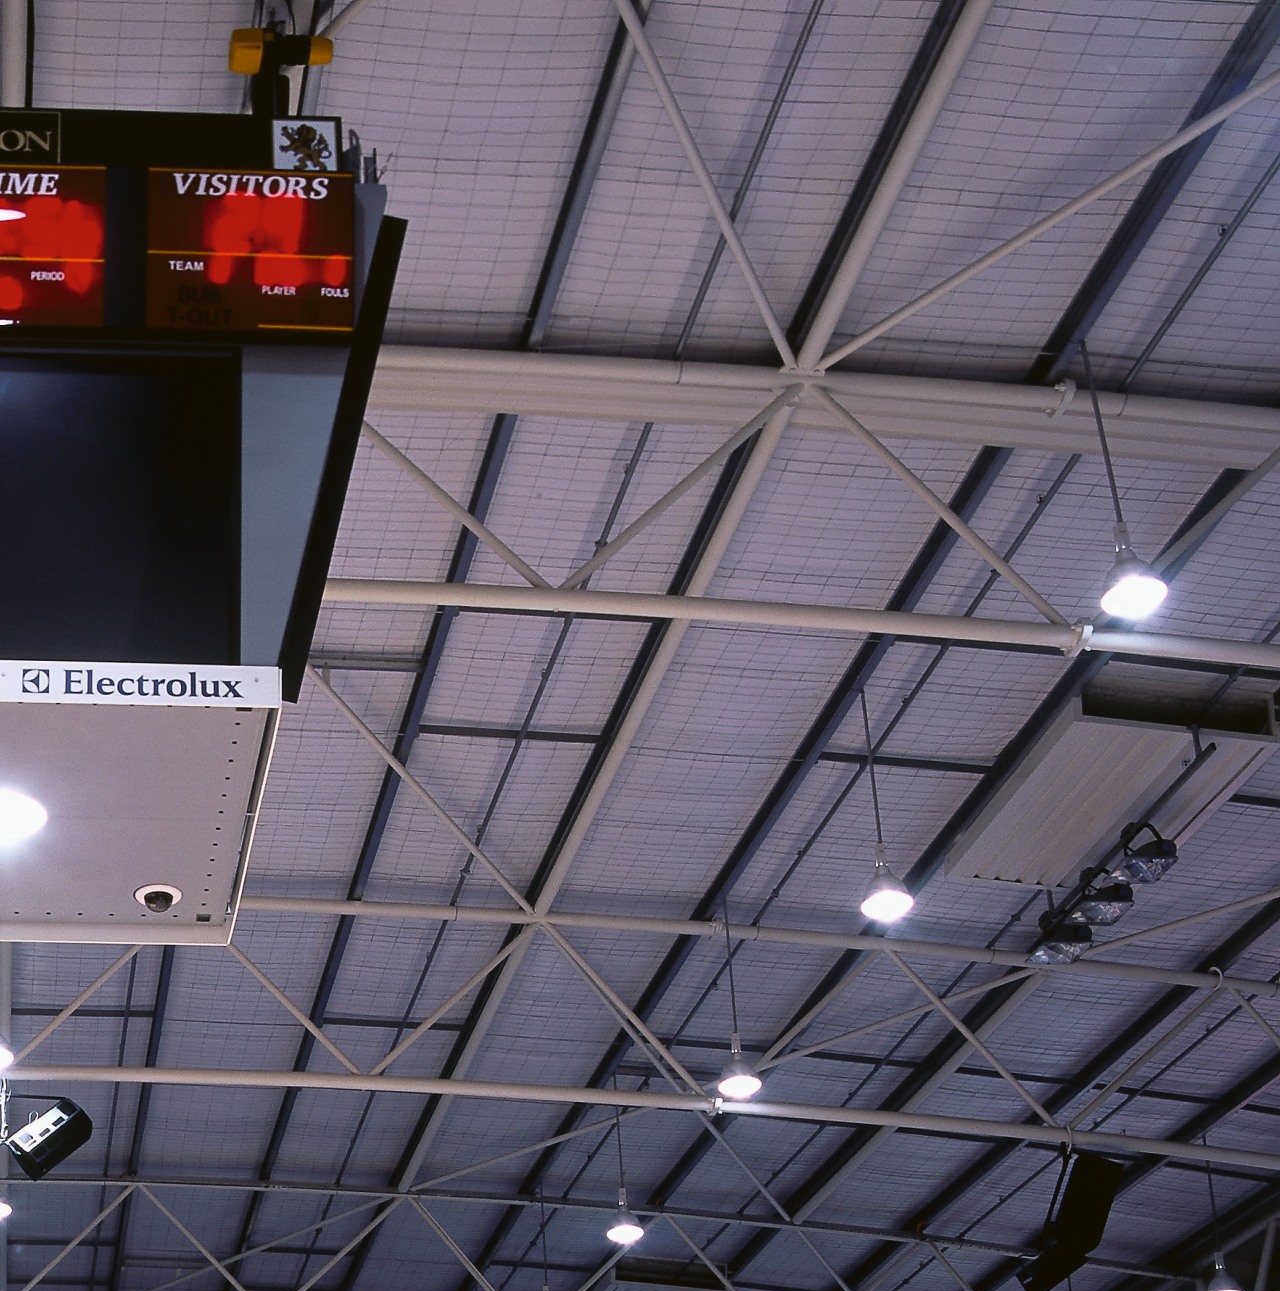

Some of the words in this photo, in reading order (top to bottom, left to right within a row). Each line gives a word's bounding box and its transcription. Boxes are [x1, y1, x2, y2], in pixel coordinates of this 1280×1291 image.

[173, 172, 329, 200] VISITORS
[168, 260, 204, 272] TEAM
[30, 270, 65, 281] PERIOD
[261, 285, 296, 296] PLAYER
[321, 287, 349, 298] FOULS
[64, 669, 245, 699] Electrolux
